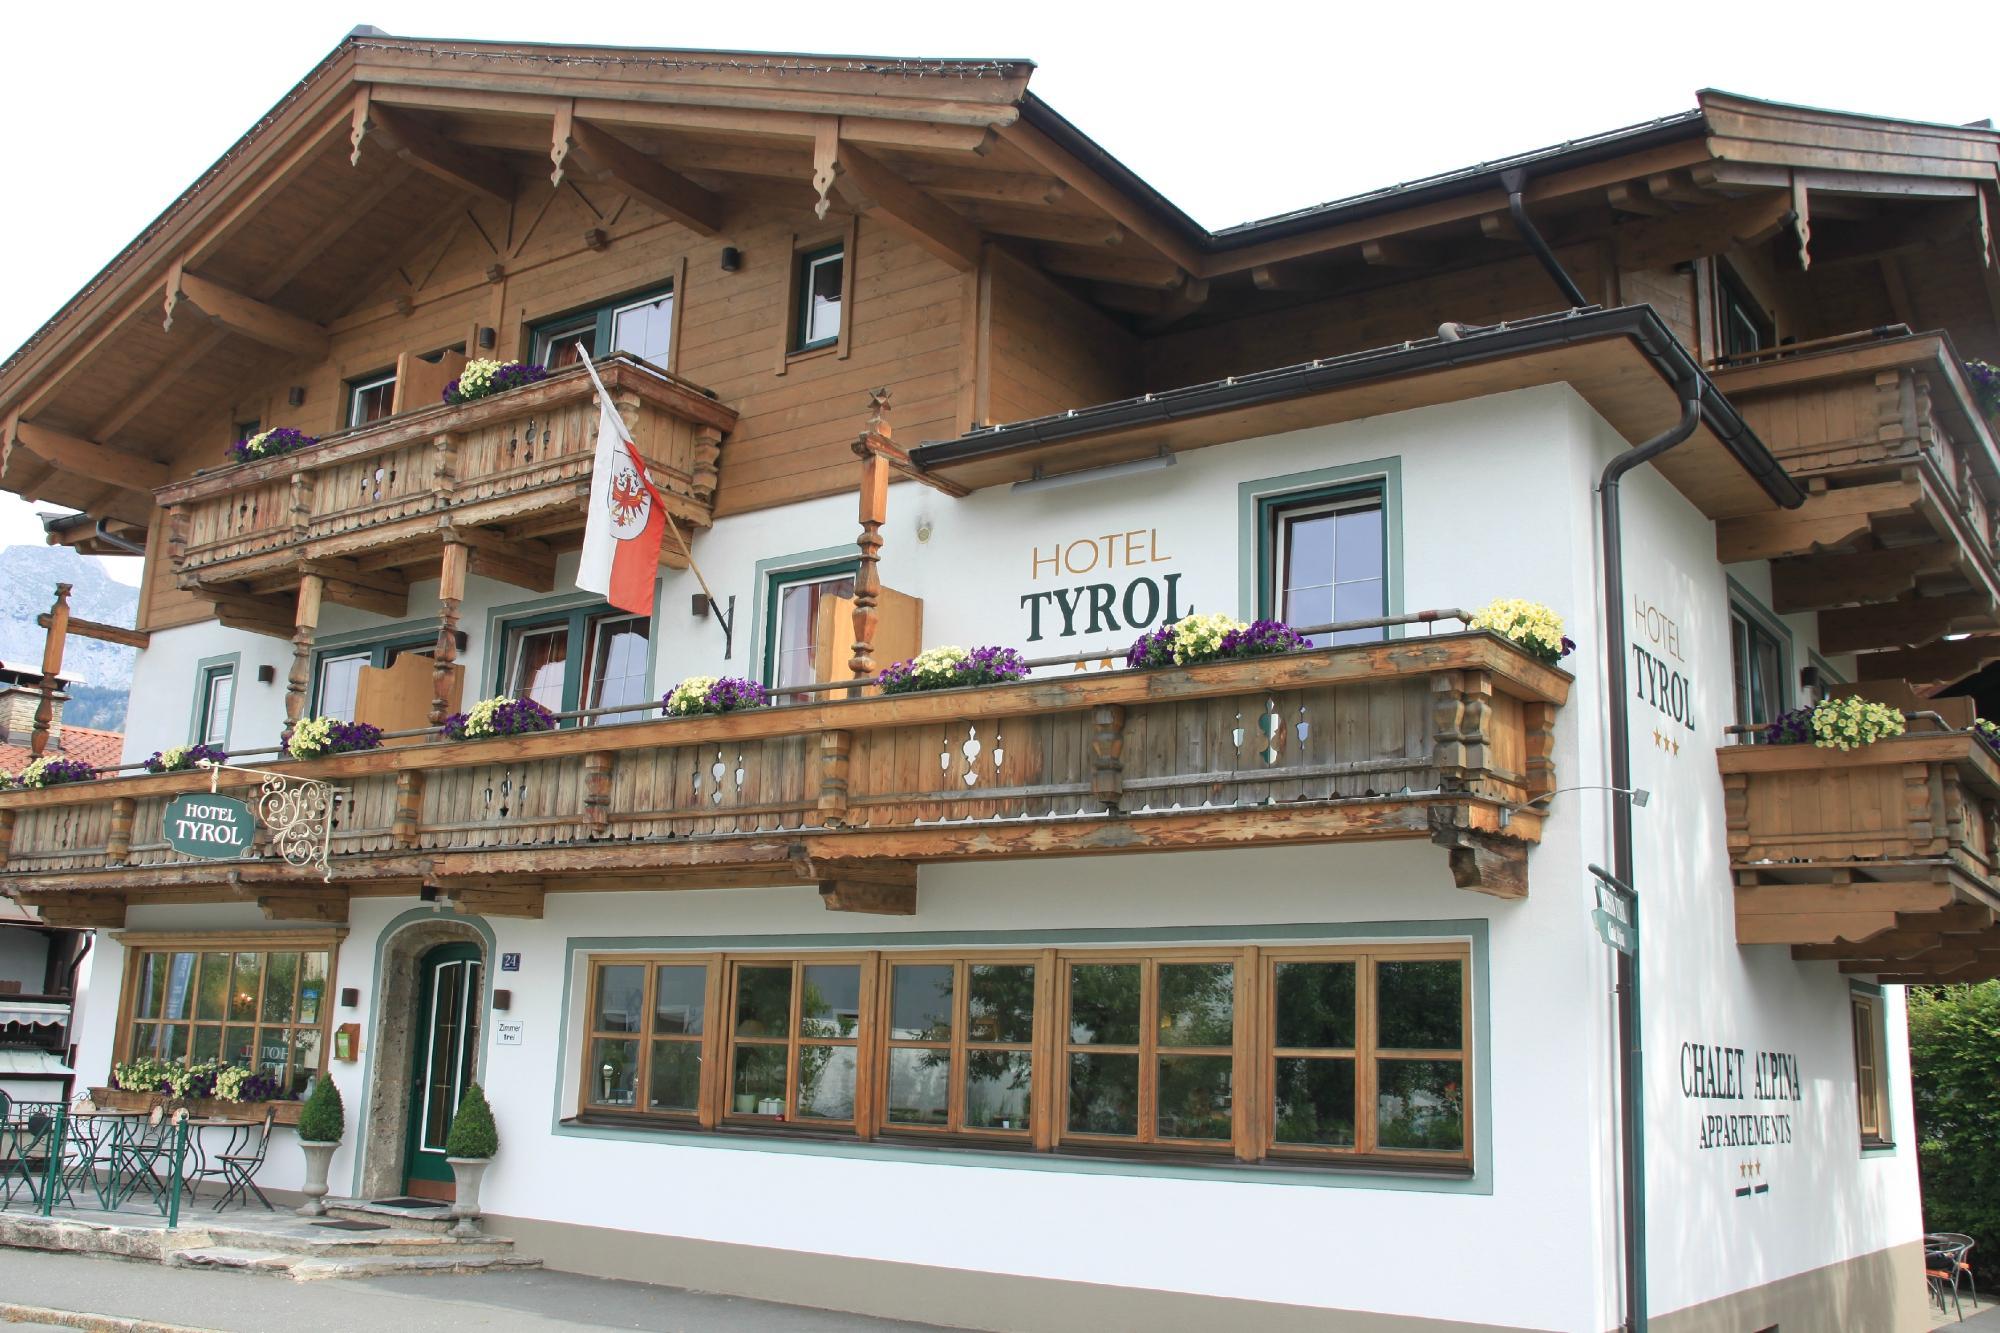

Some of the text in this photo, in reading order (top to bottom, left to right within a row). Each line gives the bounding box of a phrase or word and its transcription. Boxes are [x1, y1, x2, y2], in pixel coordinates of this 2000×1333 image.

[1033, 528, 1172, 580] HOTEL
[1021, 573, 1194, 642] TYROL
[1634, 594, 1685, 663] HOTEL
[1632, 642, 1695, 731] TYROL
[185, 803, 237, 823] HOTEL
[176, 819, 243, 845] TYROL
[504, 954, 517, 968] 24
[499, 1023, 521, 1032] Zimmer
[503, 1033, 516, 1041] frei
[1680, 1041, 1801, 1100] CHALET ALPINA
[1699, 1114, 1791, 1149] APPARTEMENTS
